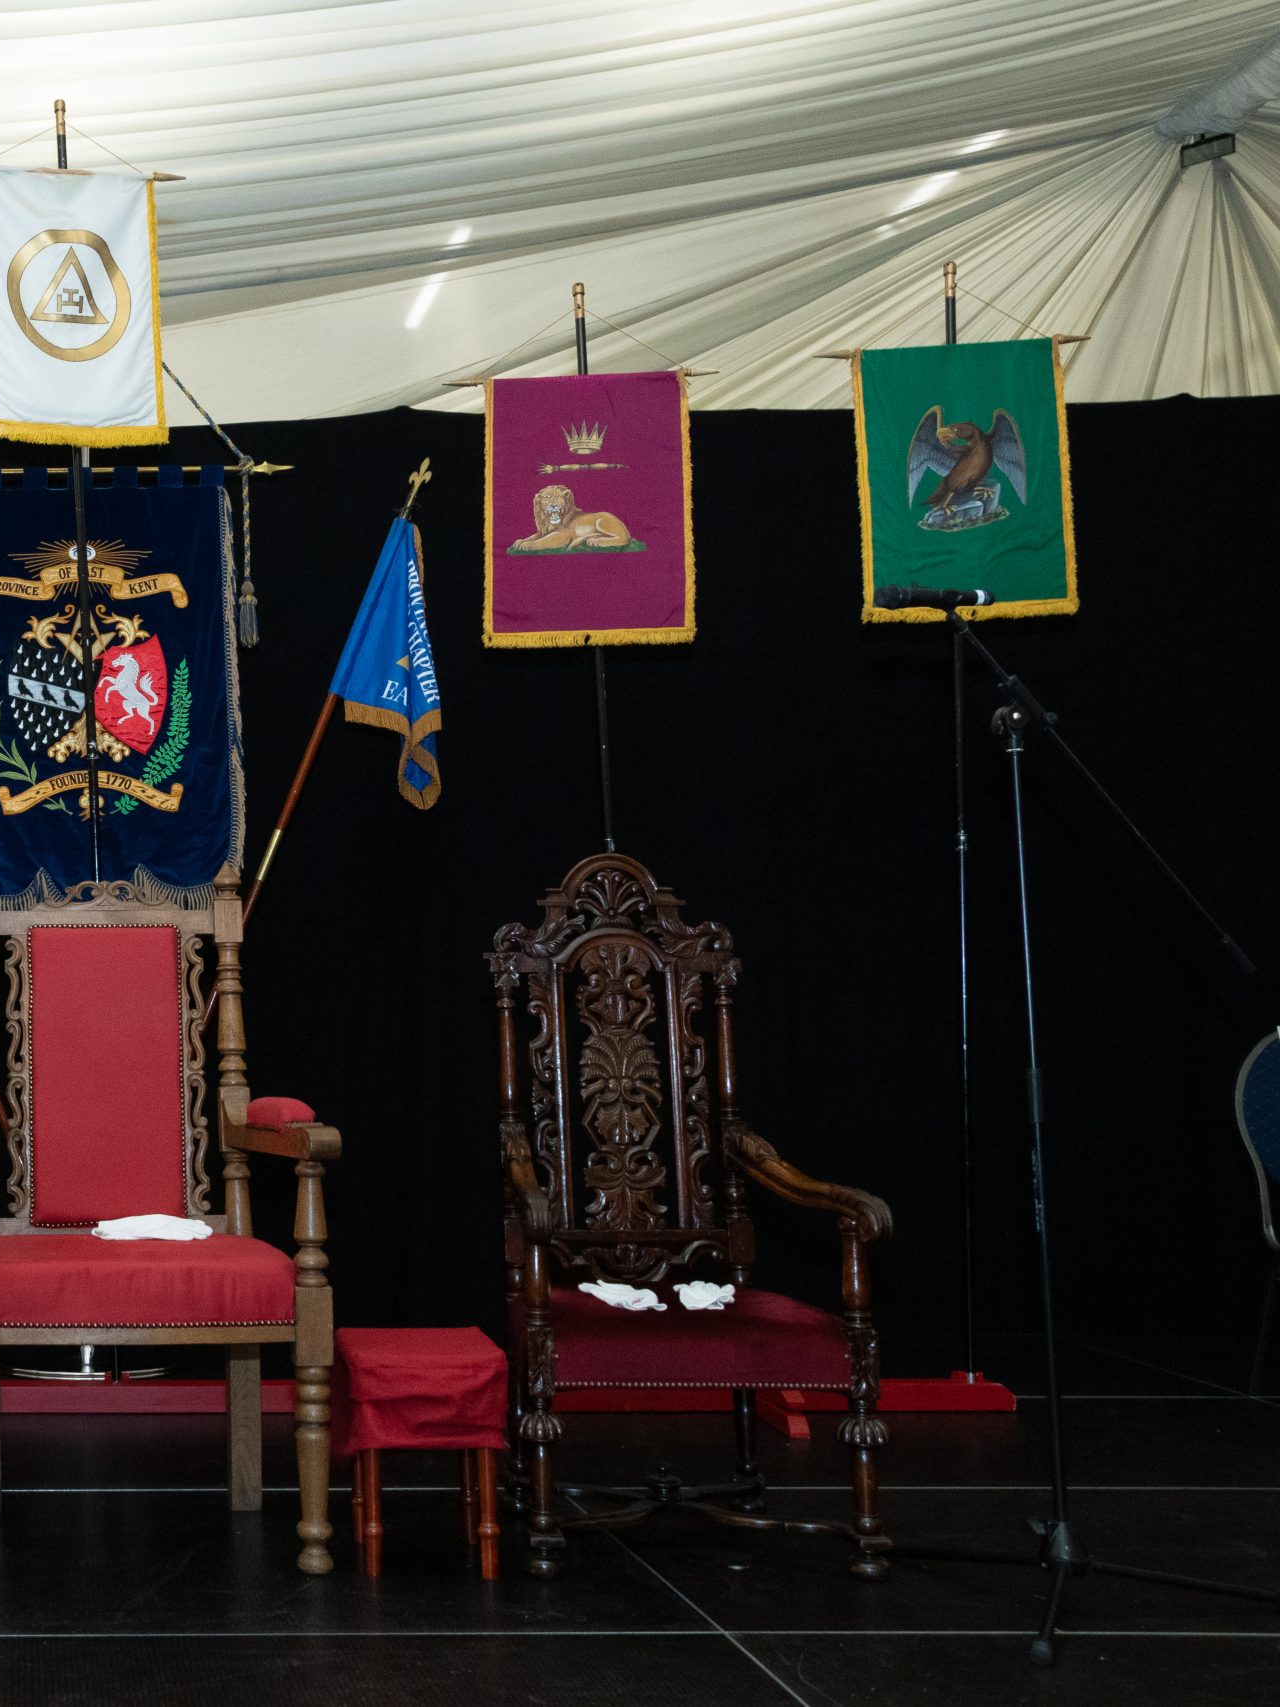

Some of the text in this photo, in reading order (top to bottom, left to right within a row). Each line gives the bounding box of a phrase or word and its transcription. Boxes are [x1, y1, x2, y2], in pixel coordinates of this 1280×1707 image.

[58, 566, 72, 580] OF
[128, 578, 158, 595] KENT
[49, 773, 132, 791] FOUNDE 1770
